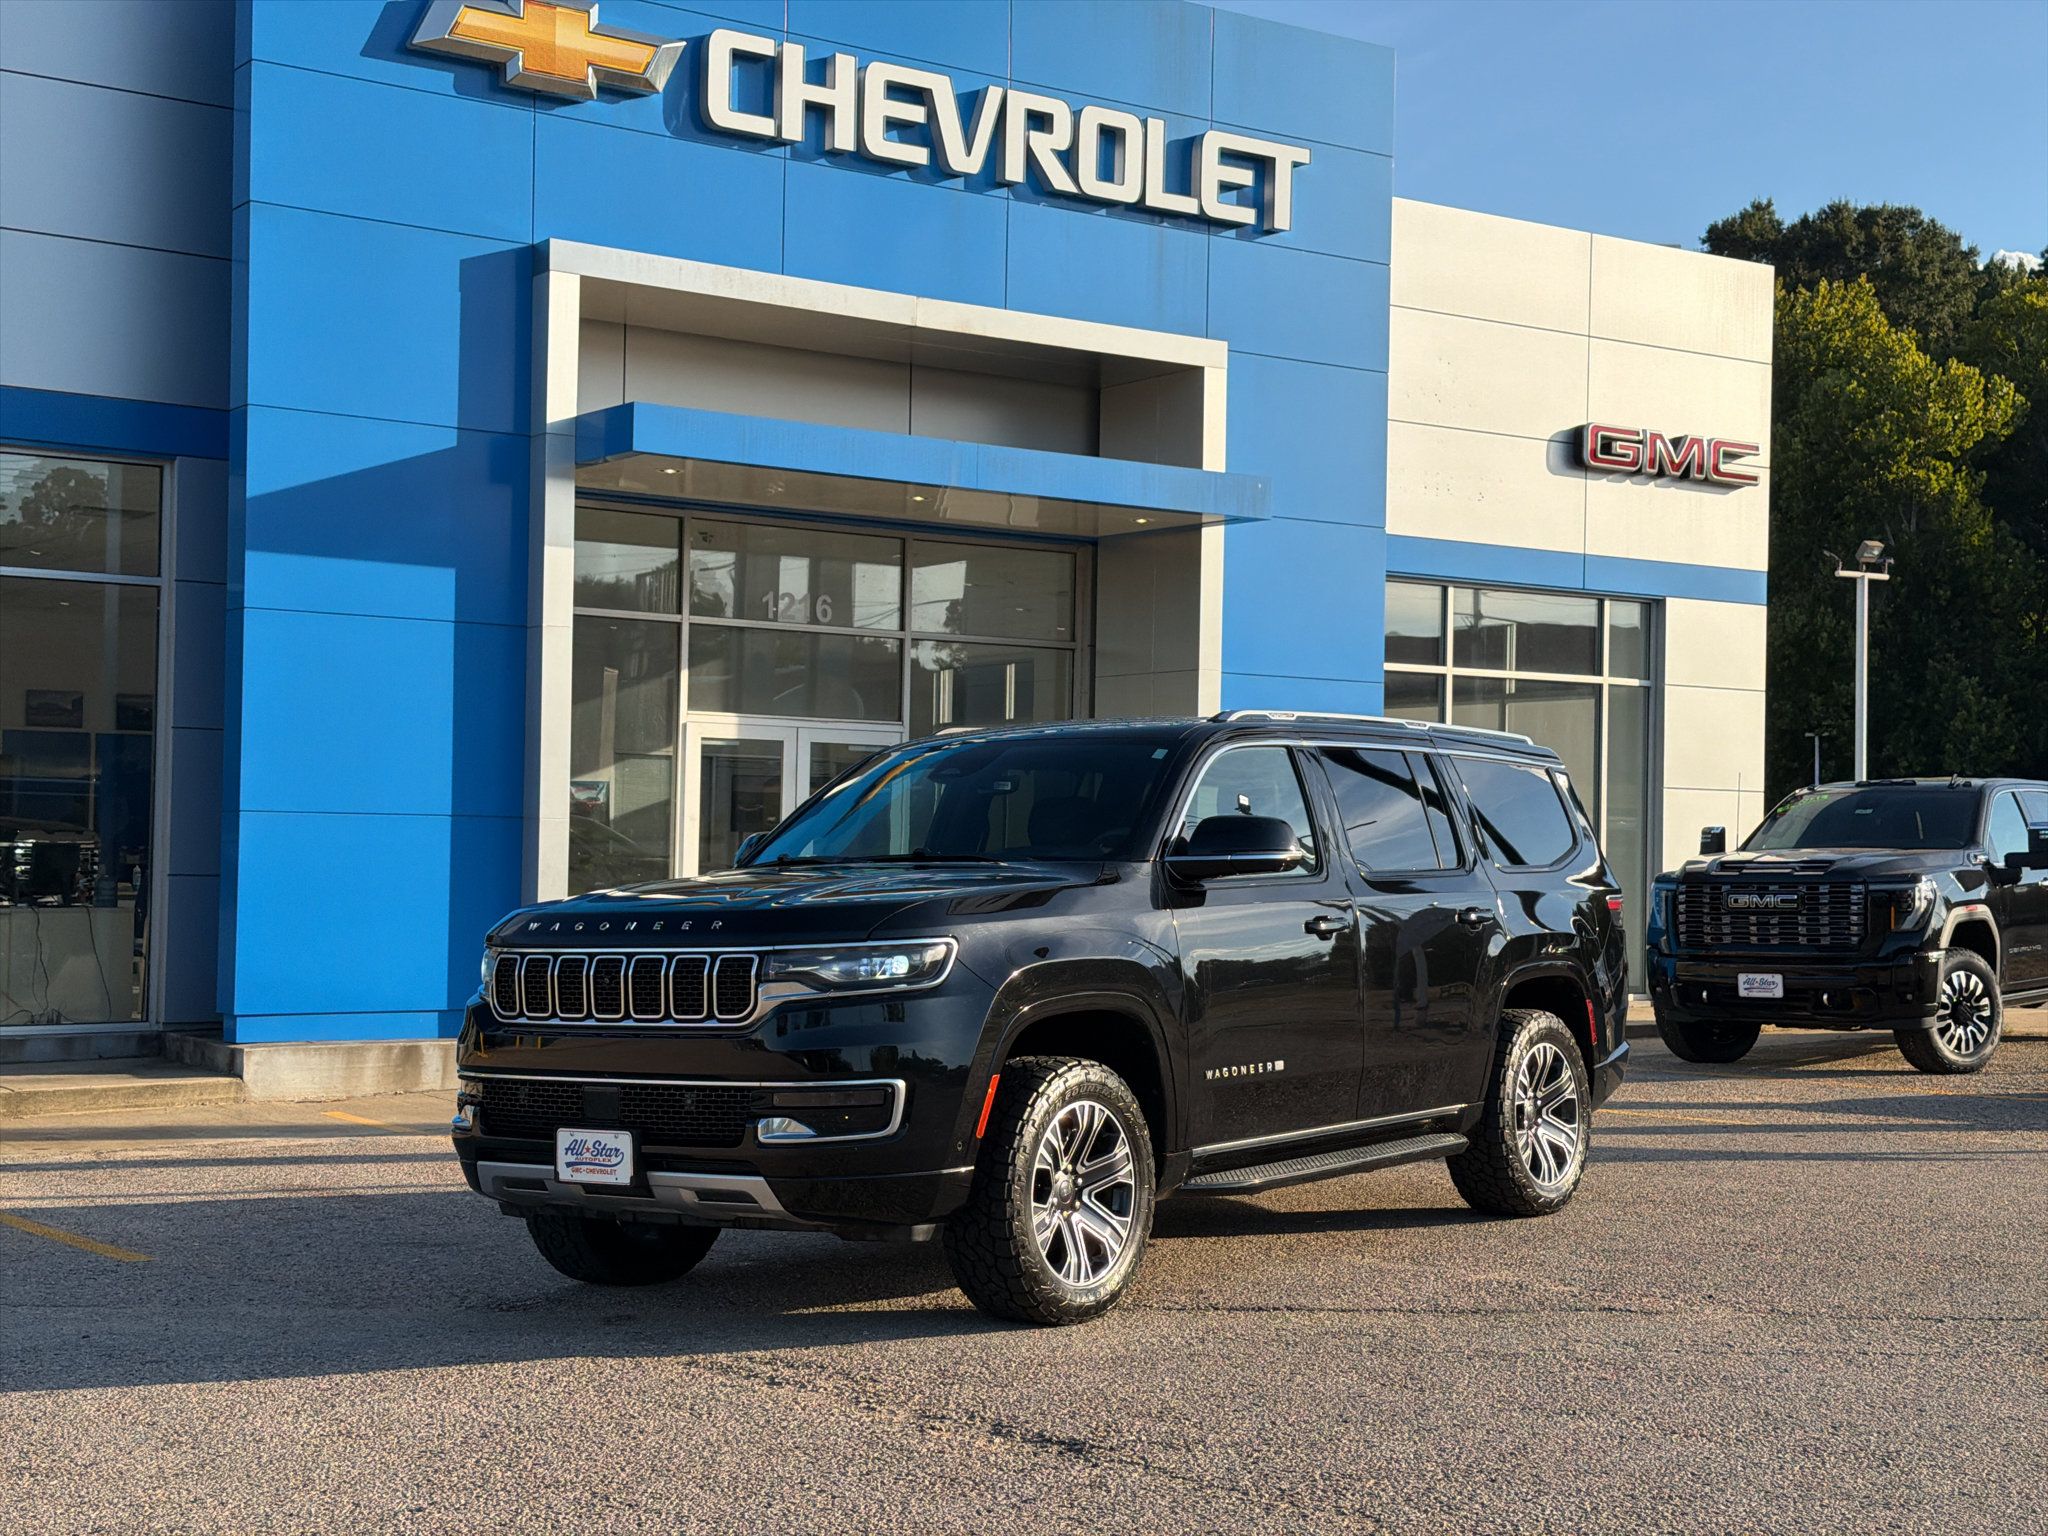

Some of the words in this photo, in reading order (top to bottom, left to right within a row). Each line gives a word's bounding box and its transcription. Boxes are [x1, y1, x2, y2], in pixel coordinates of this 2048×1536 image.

[700, 28, 1312, 234] CHEVROLET
[1584, 422, 1760, 486] GMC
[761, 591, 833, 623] 1216
[1727, 894, 1798, 908] GMC
[527, 920, 723, 931] WAGONEER
[1205, 1062, 1273, 1080] WAGONEER
[564, 1139, 588, 1157] All
[590, 1140, 622, 1158] Star
